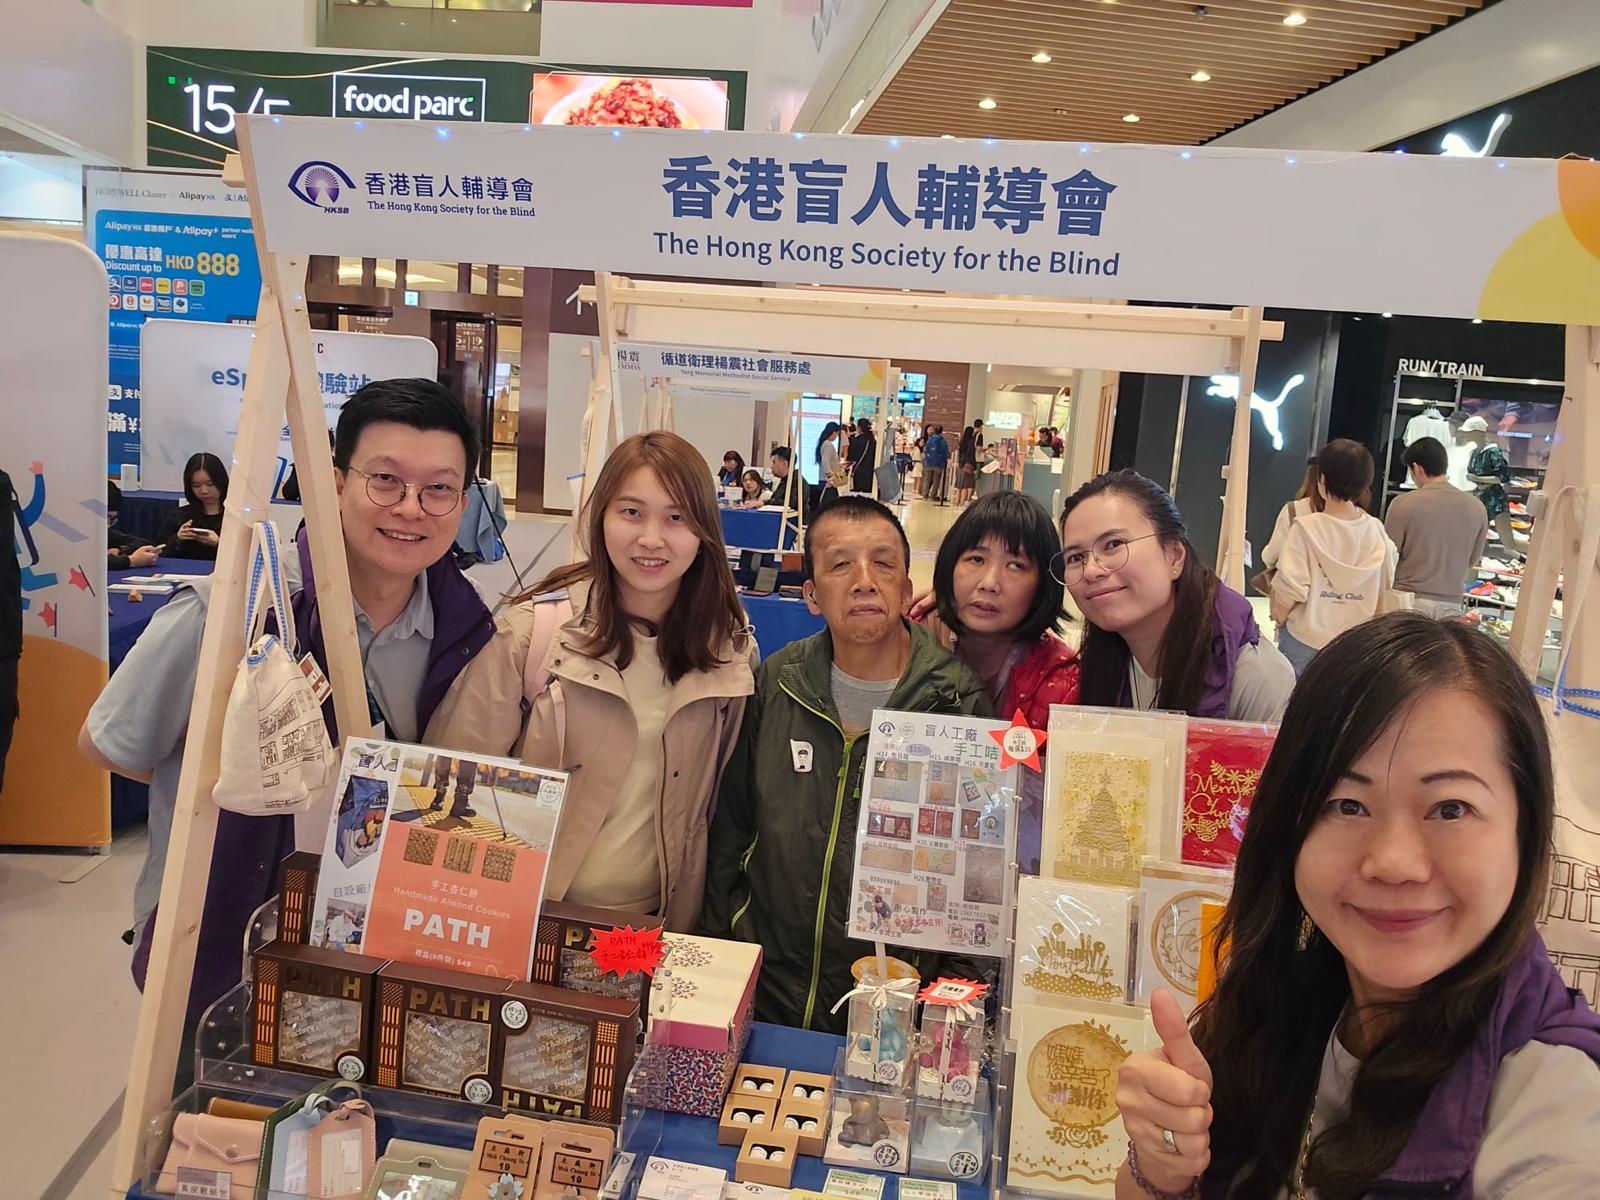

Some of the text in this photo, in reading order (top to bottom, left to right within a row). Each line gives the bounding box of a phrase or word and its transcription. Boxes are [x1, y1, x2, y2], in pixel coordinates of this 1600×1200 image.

[343, 84, 475, 120] food parc
[364, 171, 534, 203] 香港盲人輔導會
[662, 154, 1117, 237] 香港盲人輔導會
[323, 206, 350, 215] HKSB
[367, 200, 536, 217] The Hong Kong Society for the Blind
[165, 251, 241, 277] HKD 888
[653, 231, 1120, 277] The Hong Kong Society for the Blind
[105, 260, 162, 274] Discount up to
[660, 351, 812, 376] 循道衛理楊震社會服務處
[1398, 358, 1485, 377] RUN/TRAIN
[925, 723, 978, 742] 盲人工廠
[953, 742, 999, 761] 手工咭
[393, 885, 511, 920] Handmade Almond Cookies
[403, 907, 491, 949] PATH
[409, 985, 491, 1021] PATH
[498, 1162, 511, 1172] 19
[570, 1174, 583, 1185] 19
